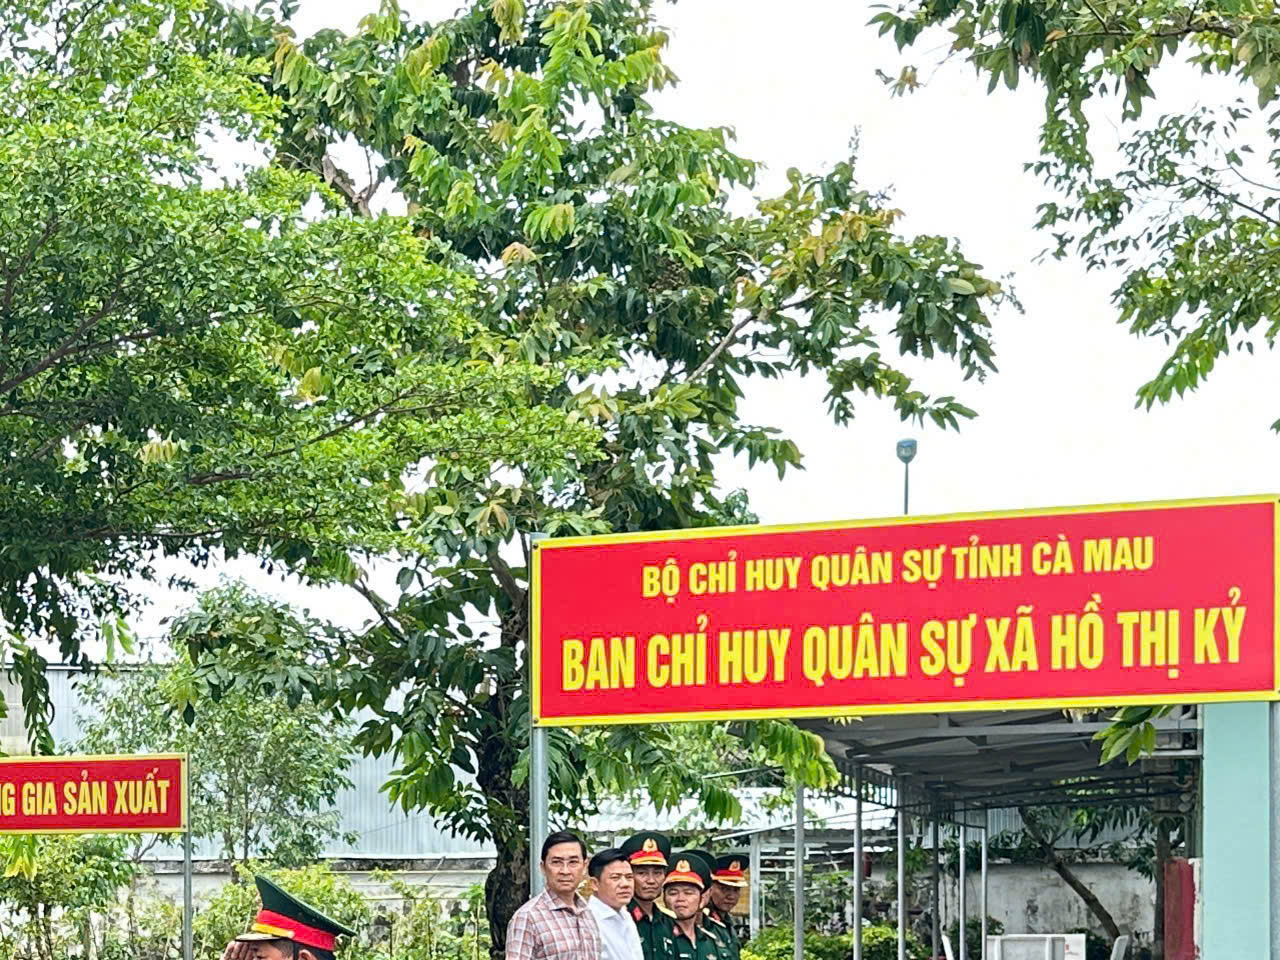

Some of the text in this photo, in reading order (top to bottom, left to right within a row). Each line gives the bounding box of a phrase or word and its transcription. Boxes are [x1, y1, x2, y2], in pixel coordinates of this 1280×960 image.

[643, 533, 1154, 603] BỘ CHỈ HUY QUÂN SỰ TỈNH CÀ MAU
[563, 586, 1247, 691] BAN CHỈ HUY QUÂN SỰ XÃ HỒ THỊ KỶ
[22, 782, 57, 816] GIA
[63, 769, 108, 816] SẢN
[113, 767, 170, 815] XUẤT
